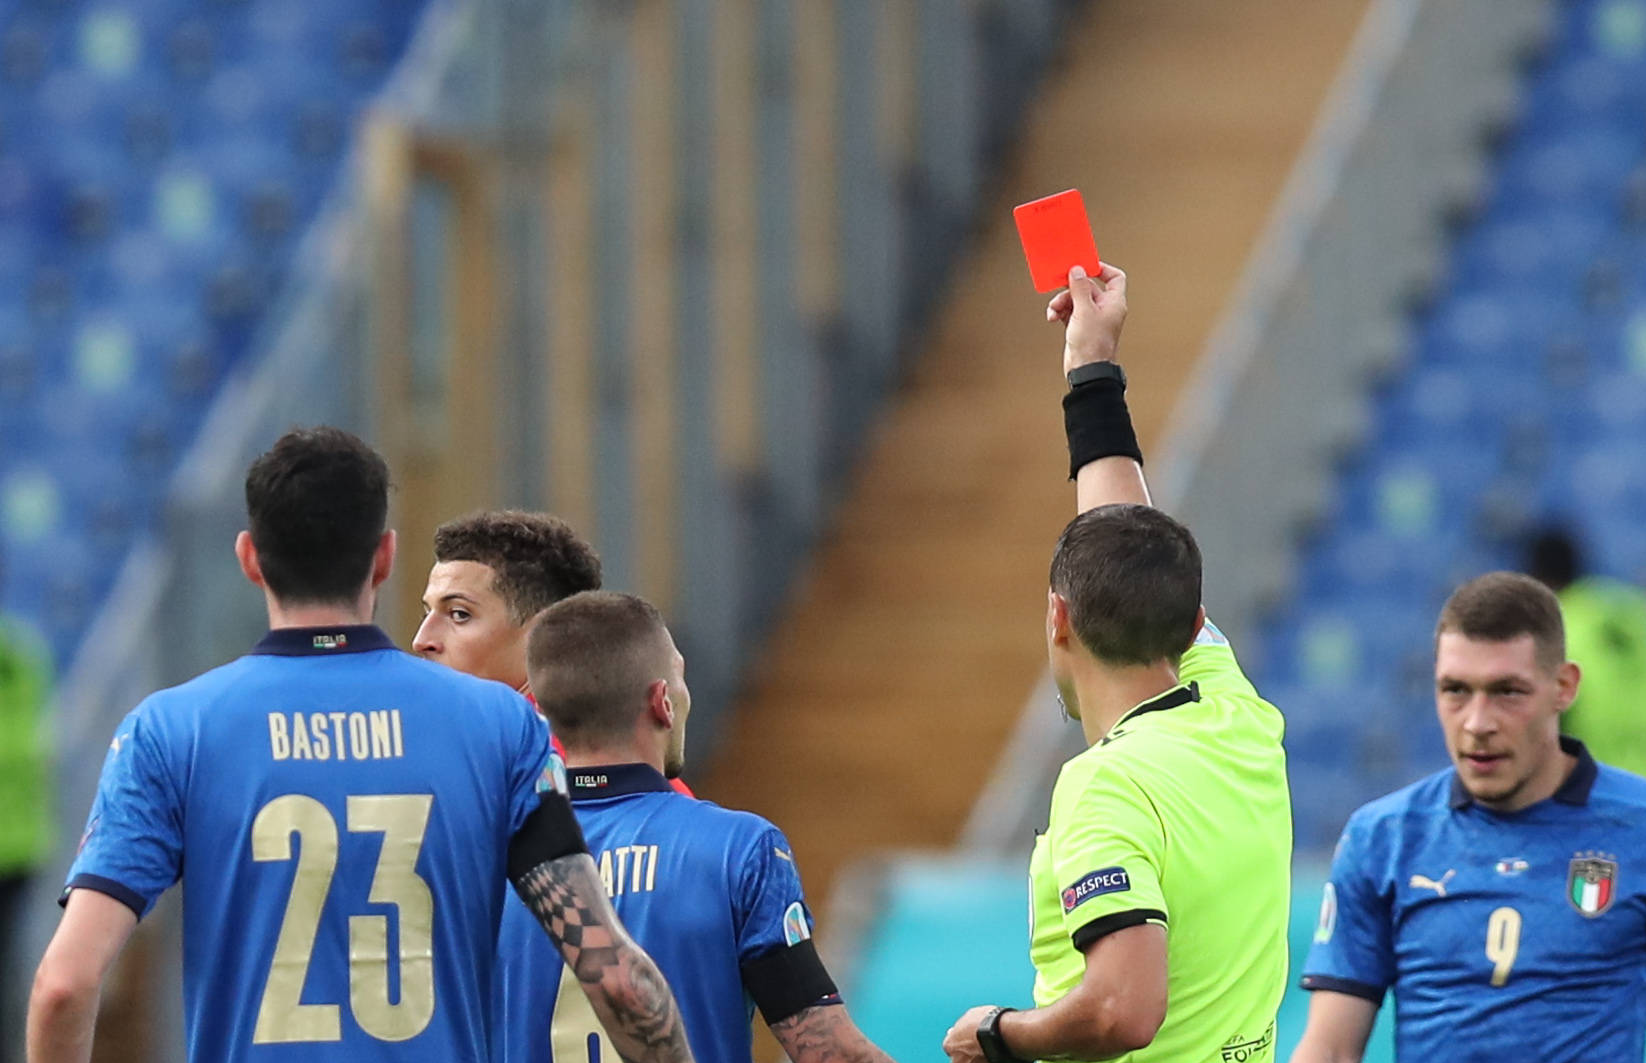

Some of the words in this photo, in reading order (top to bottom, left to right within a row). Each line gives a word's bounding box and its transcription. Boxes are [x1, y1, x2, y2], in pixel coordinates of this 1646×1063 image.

[268, 709, 404, 761] BASTONI
[575, 775, 608, 787] ITALIA
[1075, 872, 1127, 899] RESPECT
[252, 793, 435, 1044] 23
[1485, 906, 1523, 987] 9
